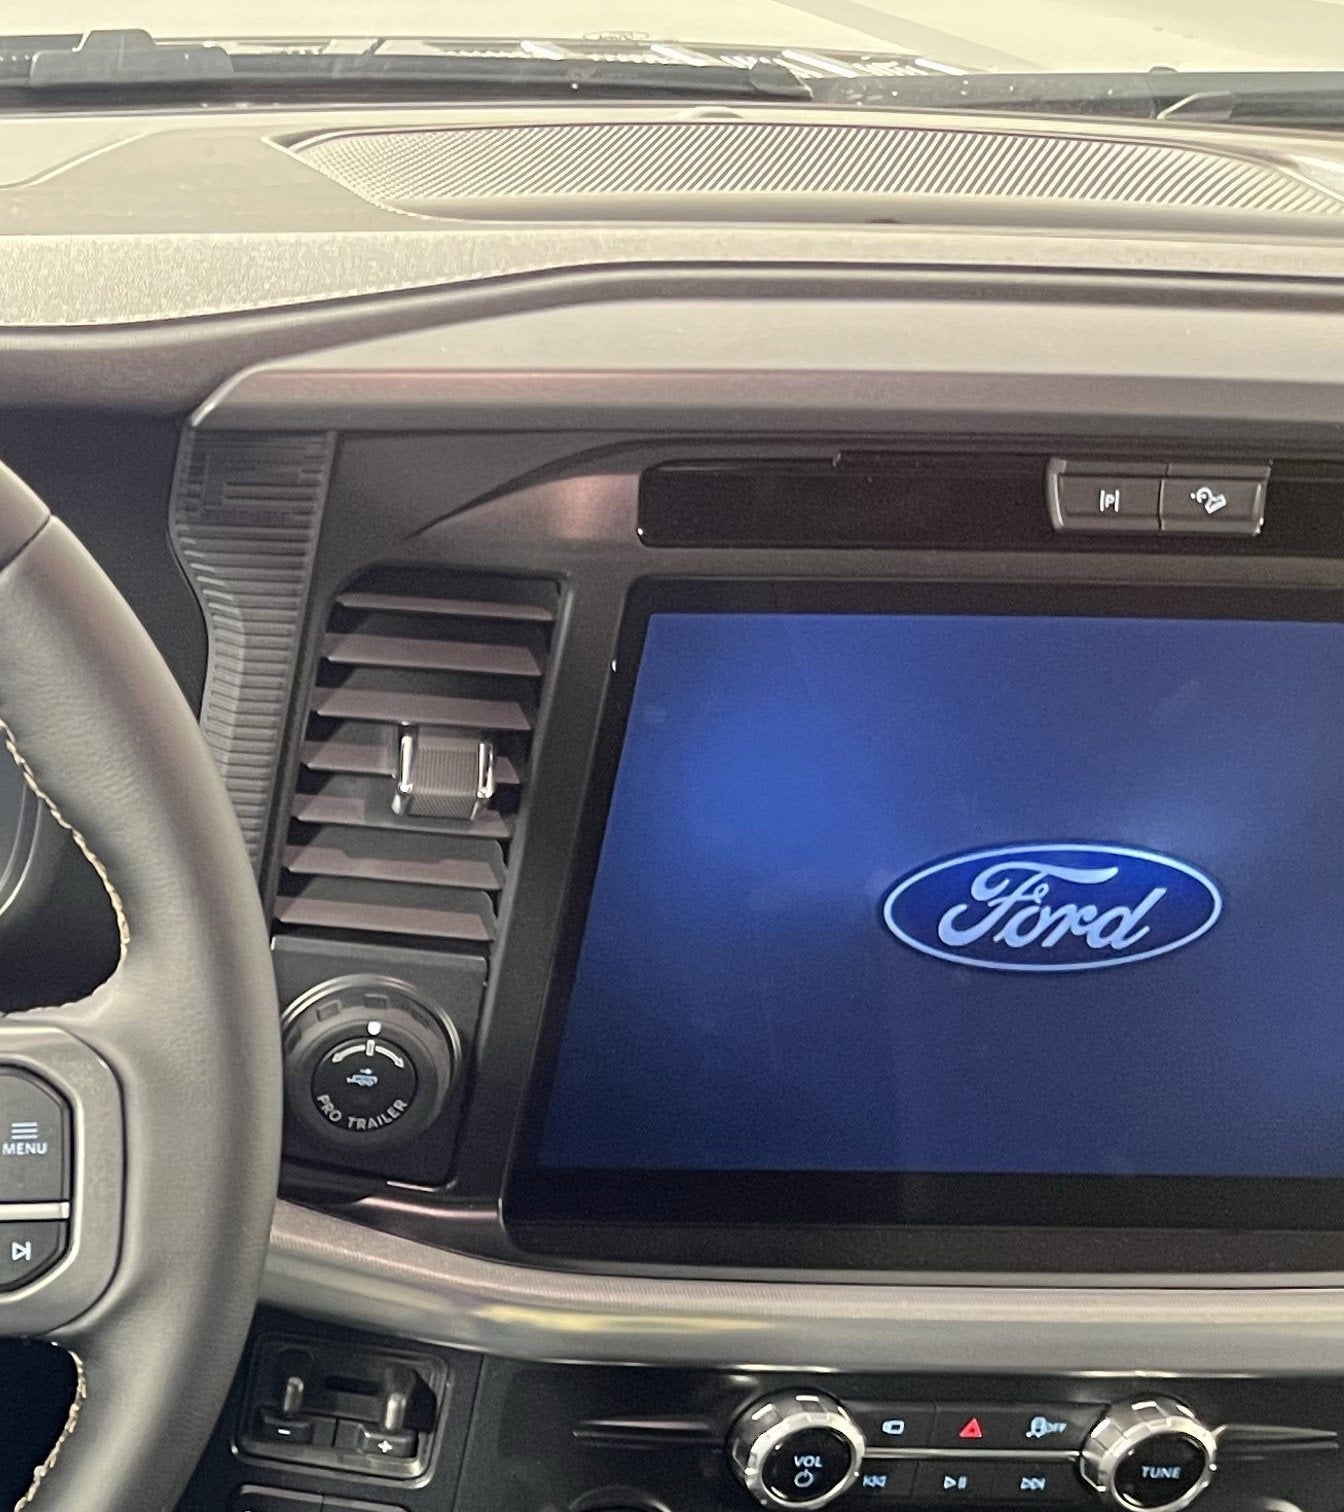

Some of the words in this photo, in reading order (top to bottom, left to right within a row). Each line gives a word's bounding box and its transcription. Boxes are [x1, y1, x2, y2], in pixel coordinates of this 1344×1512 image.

[938, 861, 1167, 949] Ford
[317, 1094, 342, 1122] PRO
[348, 1099, 408, 1130] TRAILER
[2, 1143, 48, 1155] MENU
[794, 1456, 822, 1468] VOL
[1141, 1466, 1181, 1479] TUNE
